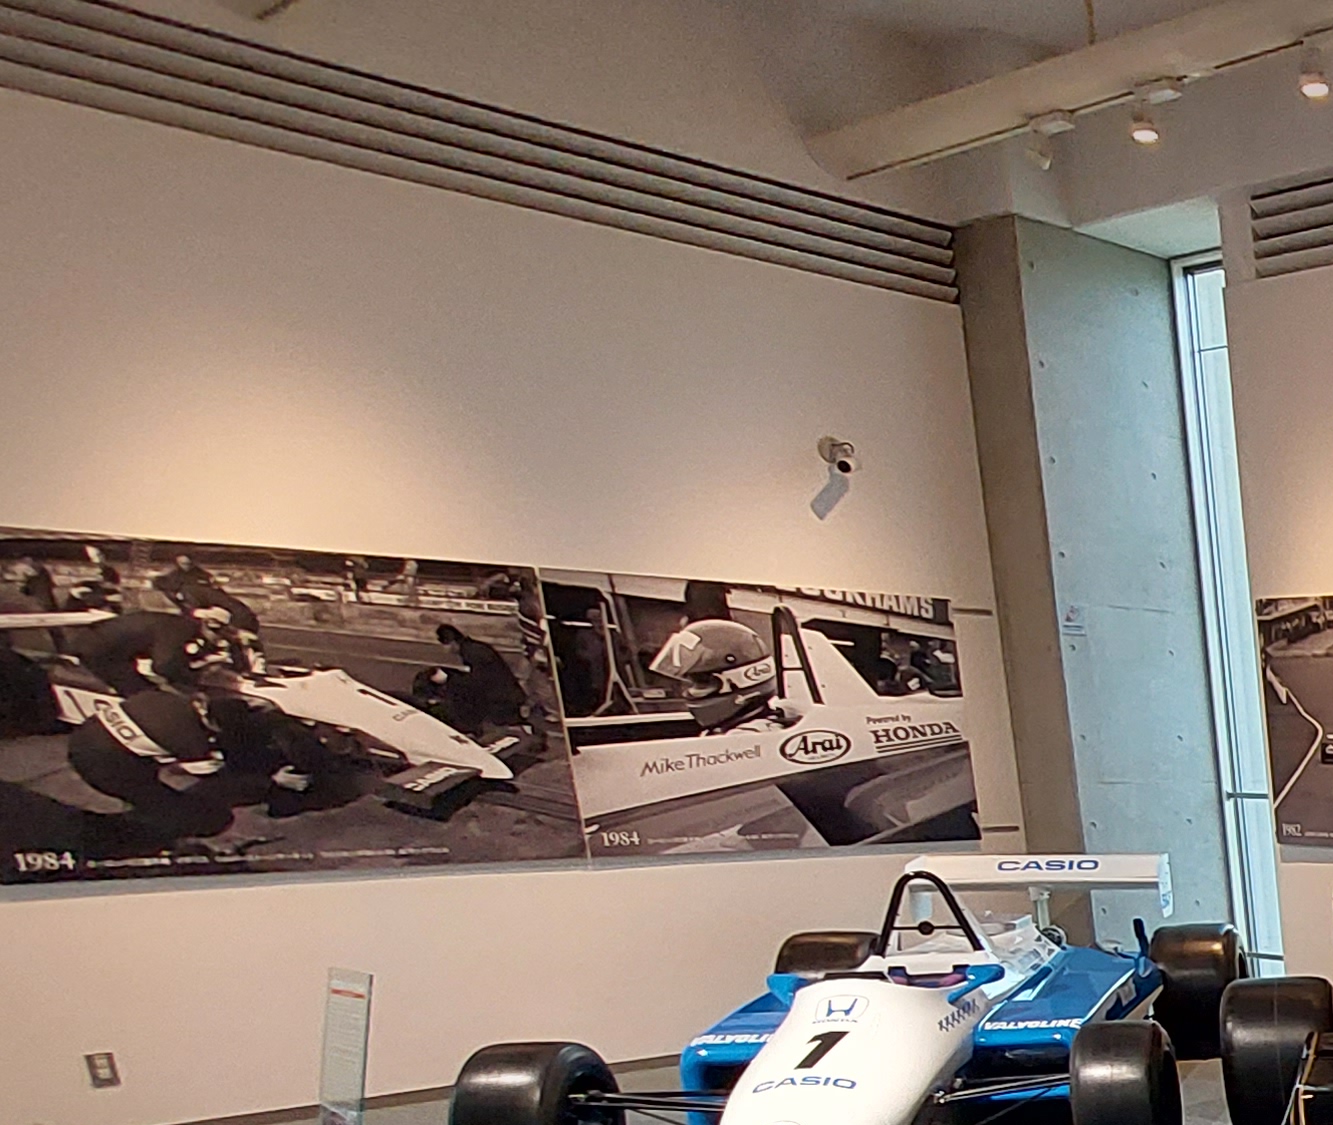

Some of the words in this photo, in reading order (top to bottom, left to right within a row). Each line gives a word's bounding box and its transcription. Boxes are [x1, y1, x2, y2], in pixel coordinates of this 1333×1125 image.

[780, 587, 934, 619] KHAMS
[869, 722, 960, 744] HONDA
[787, 734, 843, 758] Arai
[640, 758, 685, 777] Mike
[601, 832, 640, 847] 1984
[14, 851, 76, 872] 1984
[997, 860, 1099, 871] CASIO
[984, 1018, 1085, 1030] VALVOLINE
[794, 1031, 850, 1070] 1
[752, 1075, 857, 1094] CASIO
